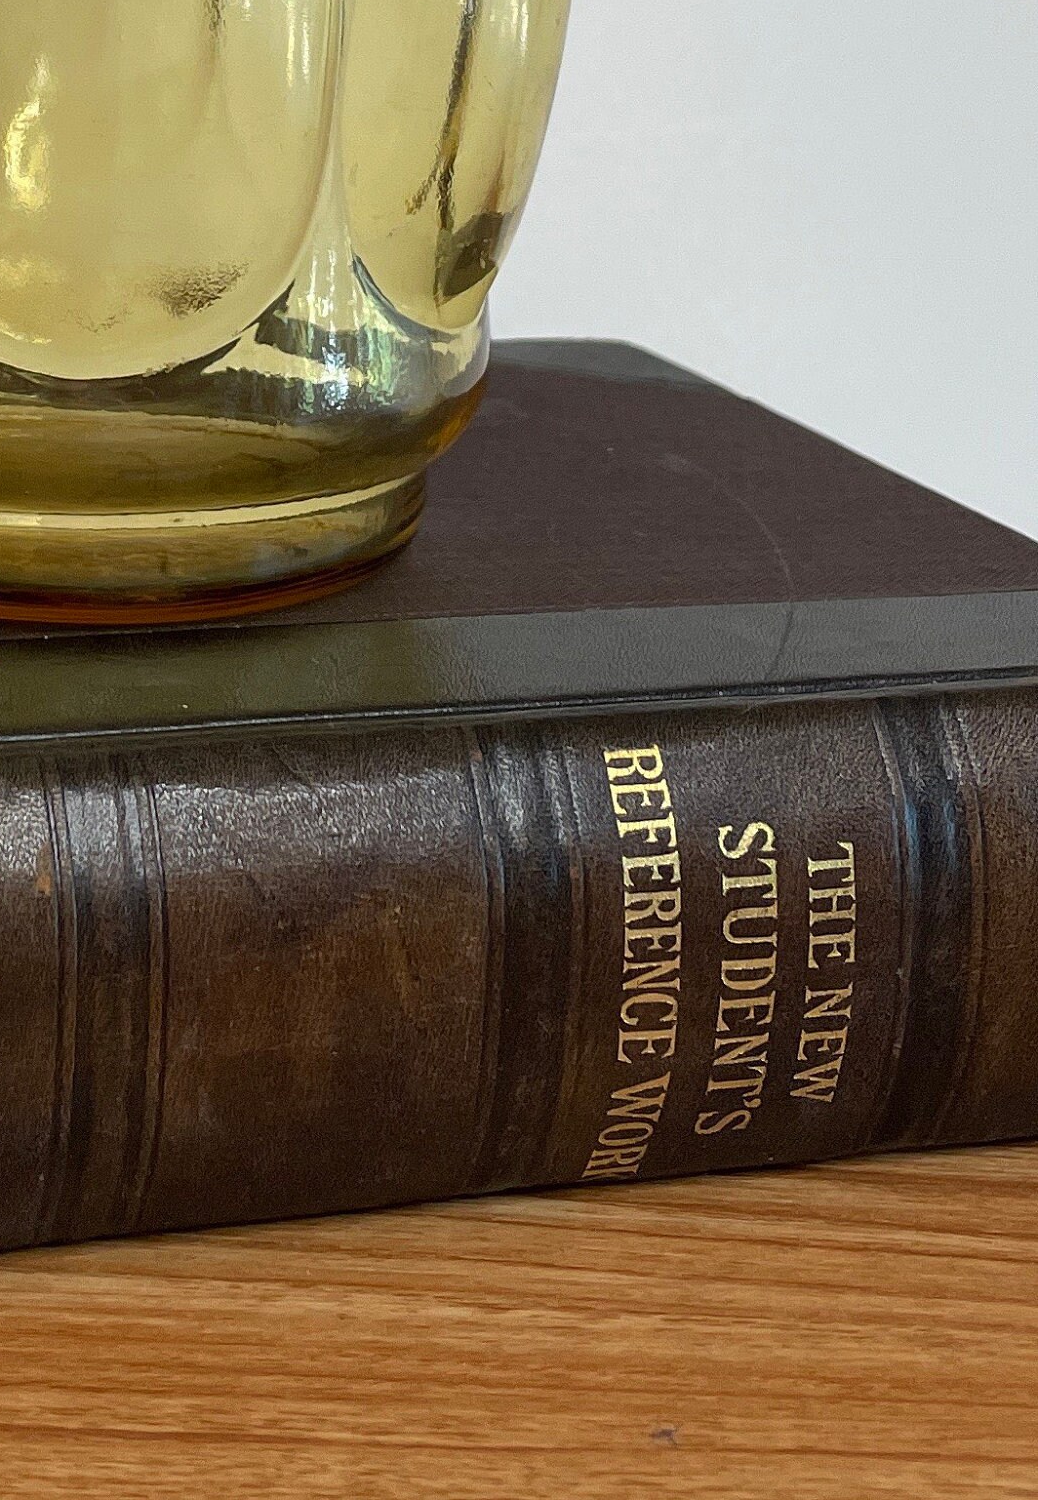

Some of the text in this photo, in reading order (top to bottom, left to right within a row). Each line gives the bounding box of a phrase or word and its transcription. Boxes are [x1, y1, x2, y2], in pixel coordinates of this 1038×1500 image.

[602, 743, 683, 1064] REFERENCE
[694, 821, 780, 1136] STUDENT'S
[789, 840, 857, 1103] THE NEW
